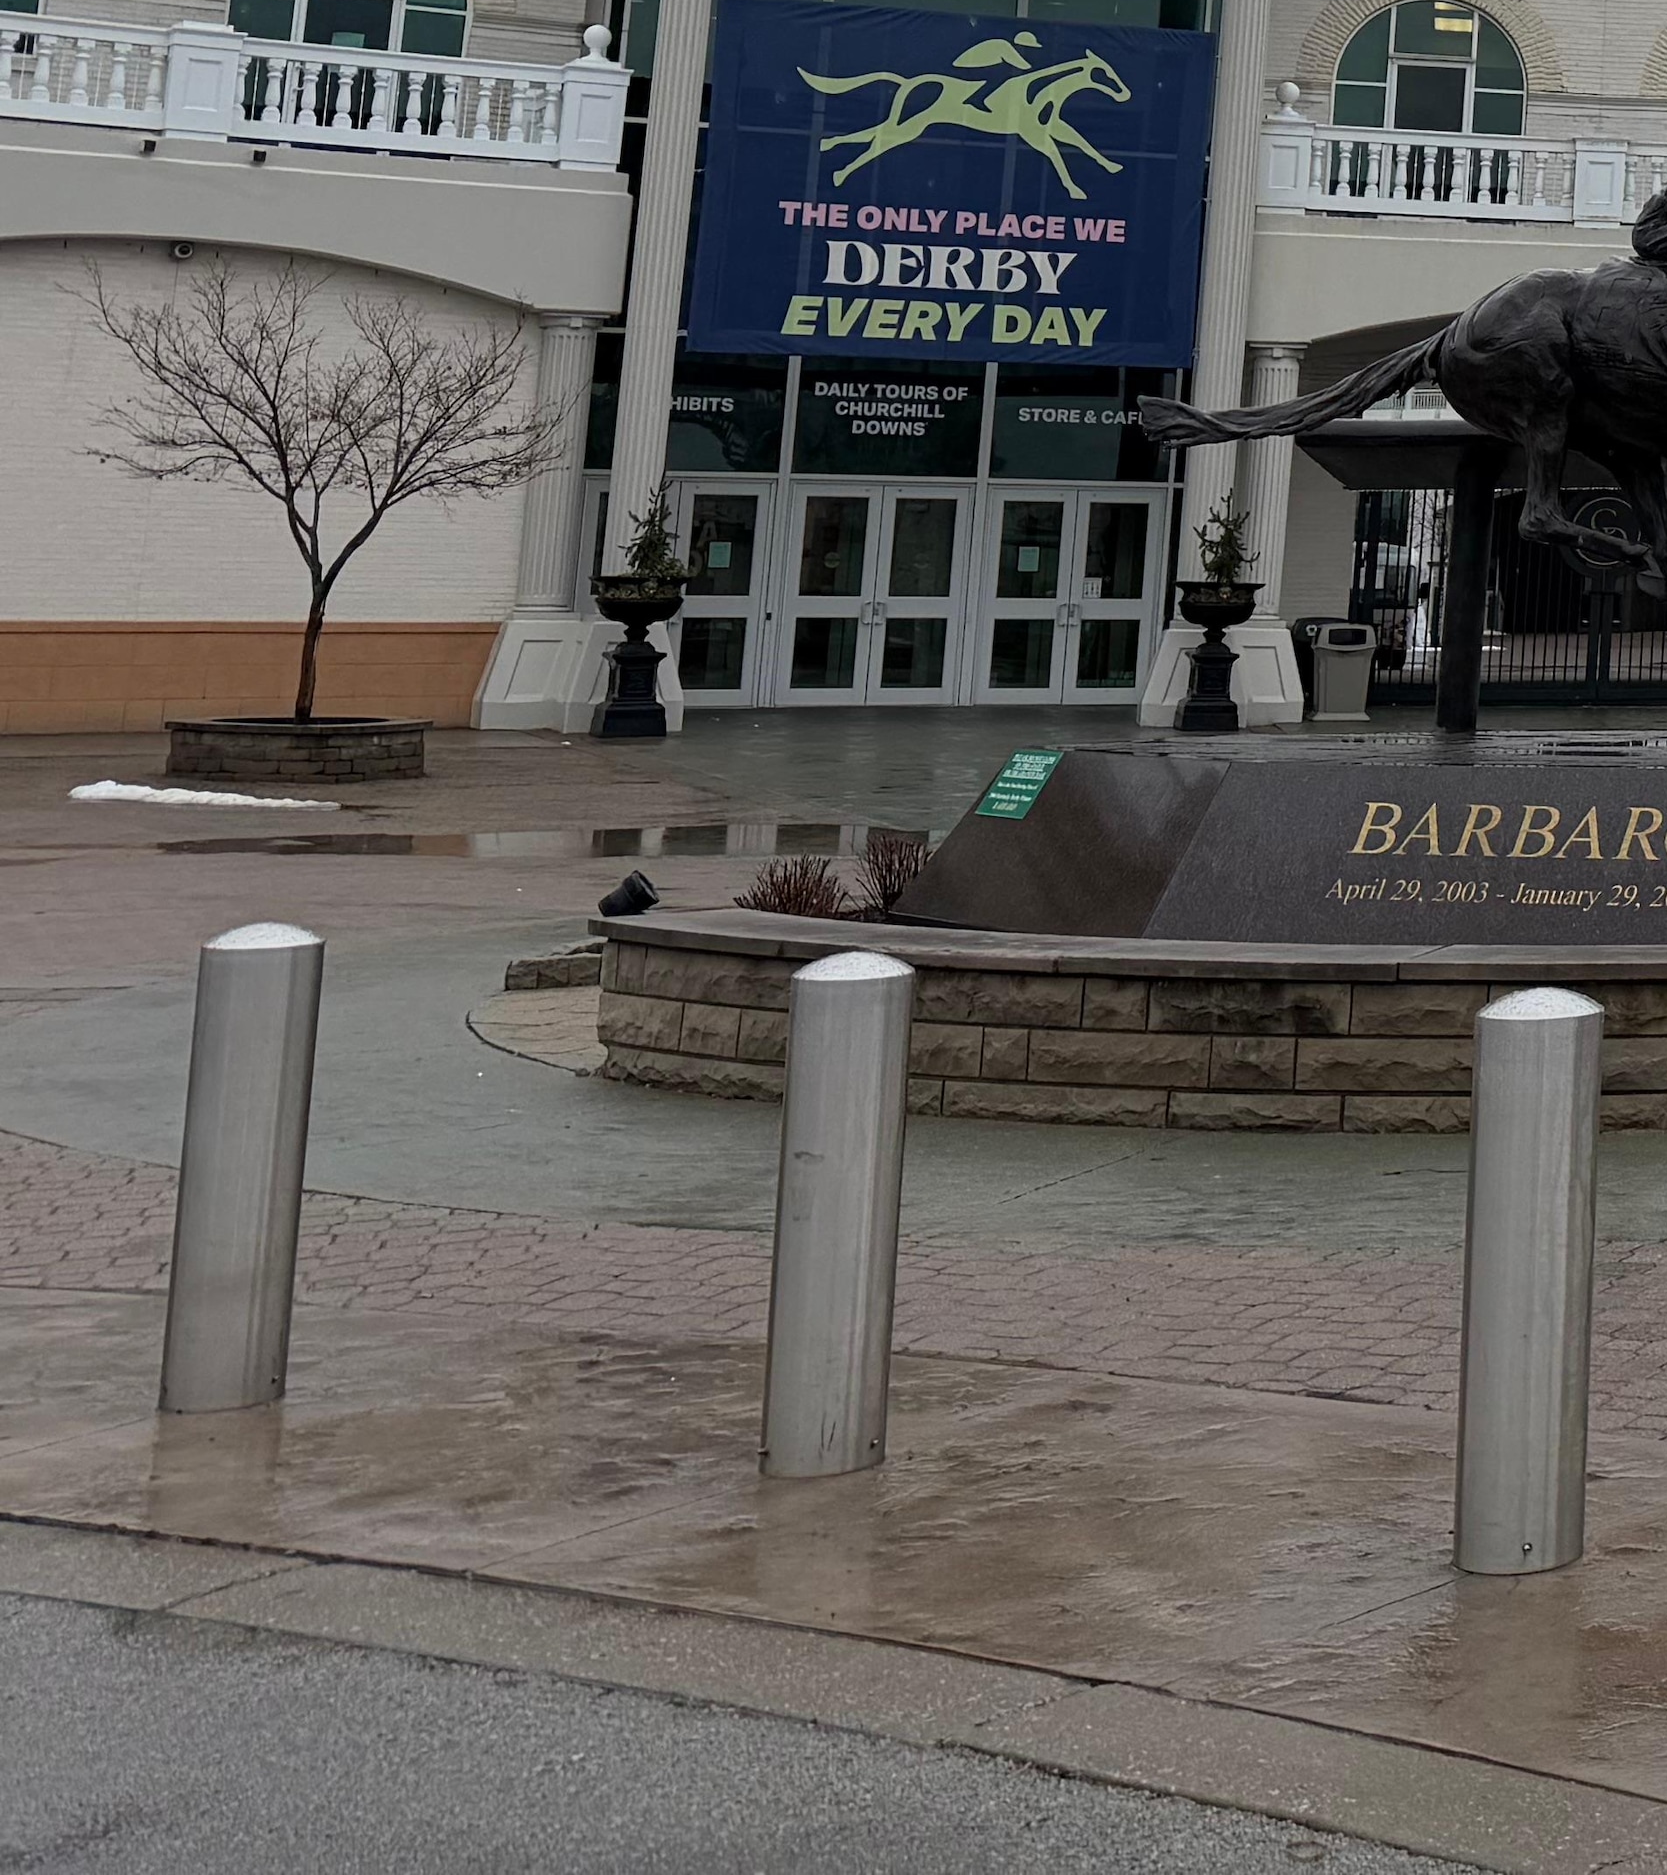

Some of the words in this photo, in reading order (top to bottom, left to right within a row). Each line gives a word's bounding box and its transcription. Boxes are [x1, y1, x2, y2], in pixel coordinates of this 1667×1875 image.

[778, 200, 849, 230] THE
[857, 205, 947, 237] ONLY
[956, 210, 1065, 240] PLACE
[1074, 217, 1126, 244] WE
[823, 240, 1078, 295] DERBY
[781, 295, 987, 344] EVERY
[992, 304, 1107, 348] DAY
[814, 381, 870, 398] DAILY
[874, 383, 939, 400] TOURS
[943, 386, 968, 400] OF
[671, 396, 734, 413] HIBITS
[835, 401, 945, 419] CHURCHILL
[1018, 408, 1080, 424] STORE
[1084, 410, 1097, 424] &
[1325, 876, 1385, 905] April
[1390, 879, 1425, 905] 29,
[1432, 879, 1489, 905] 2003
[1510, 883, 1600, 912] January
[1606, 885, 1642, 911] 29,
